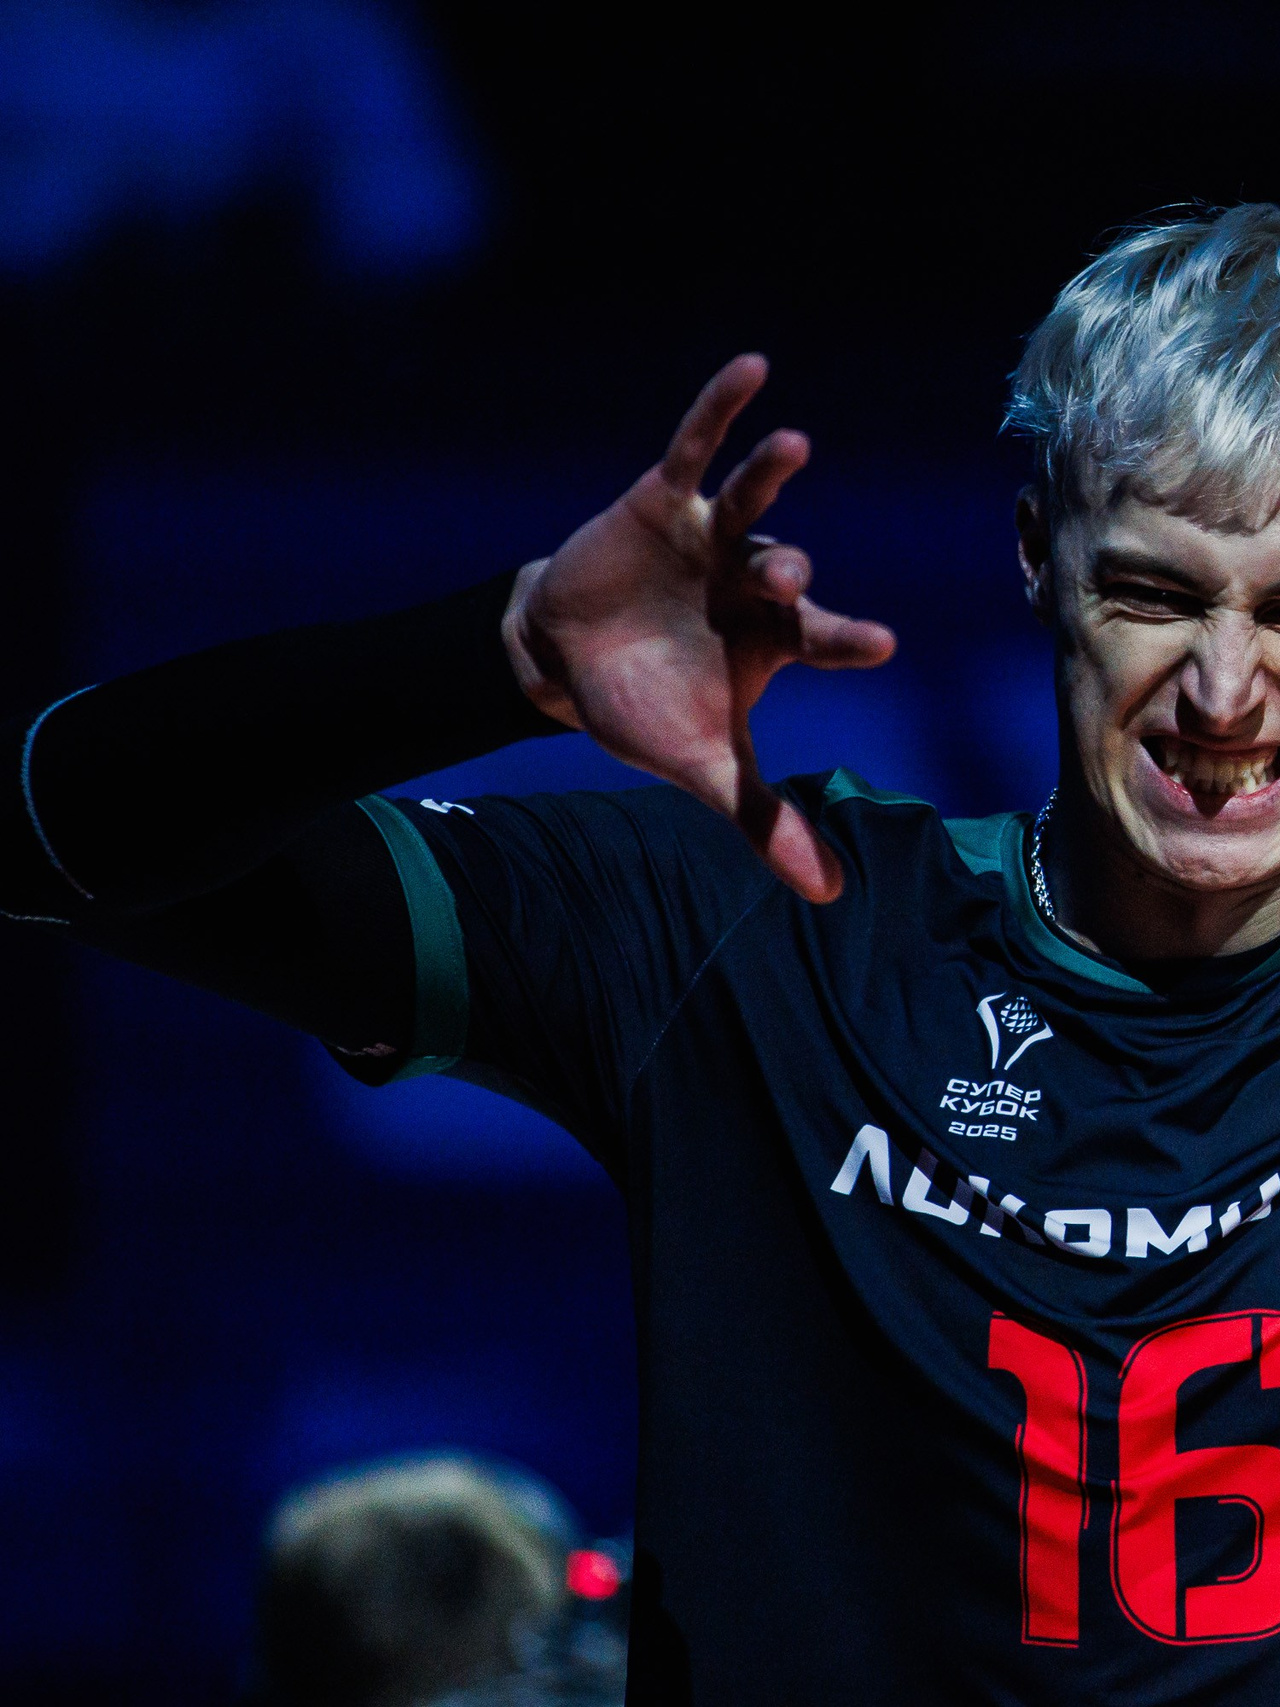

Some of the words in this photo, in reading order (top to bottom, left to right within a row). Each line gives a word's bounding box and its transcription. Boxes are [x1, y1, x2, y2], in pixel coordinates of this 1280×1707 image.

[946, 1078, 1041, 1104] СУПЕР
[939, 1094, 1040, 1121] КУБОК
[948, 1121, 1018, 1141] 2025
